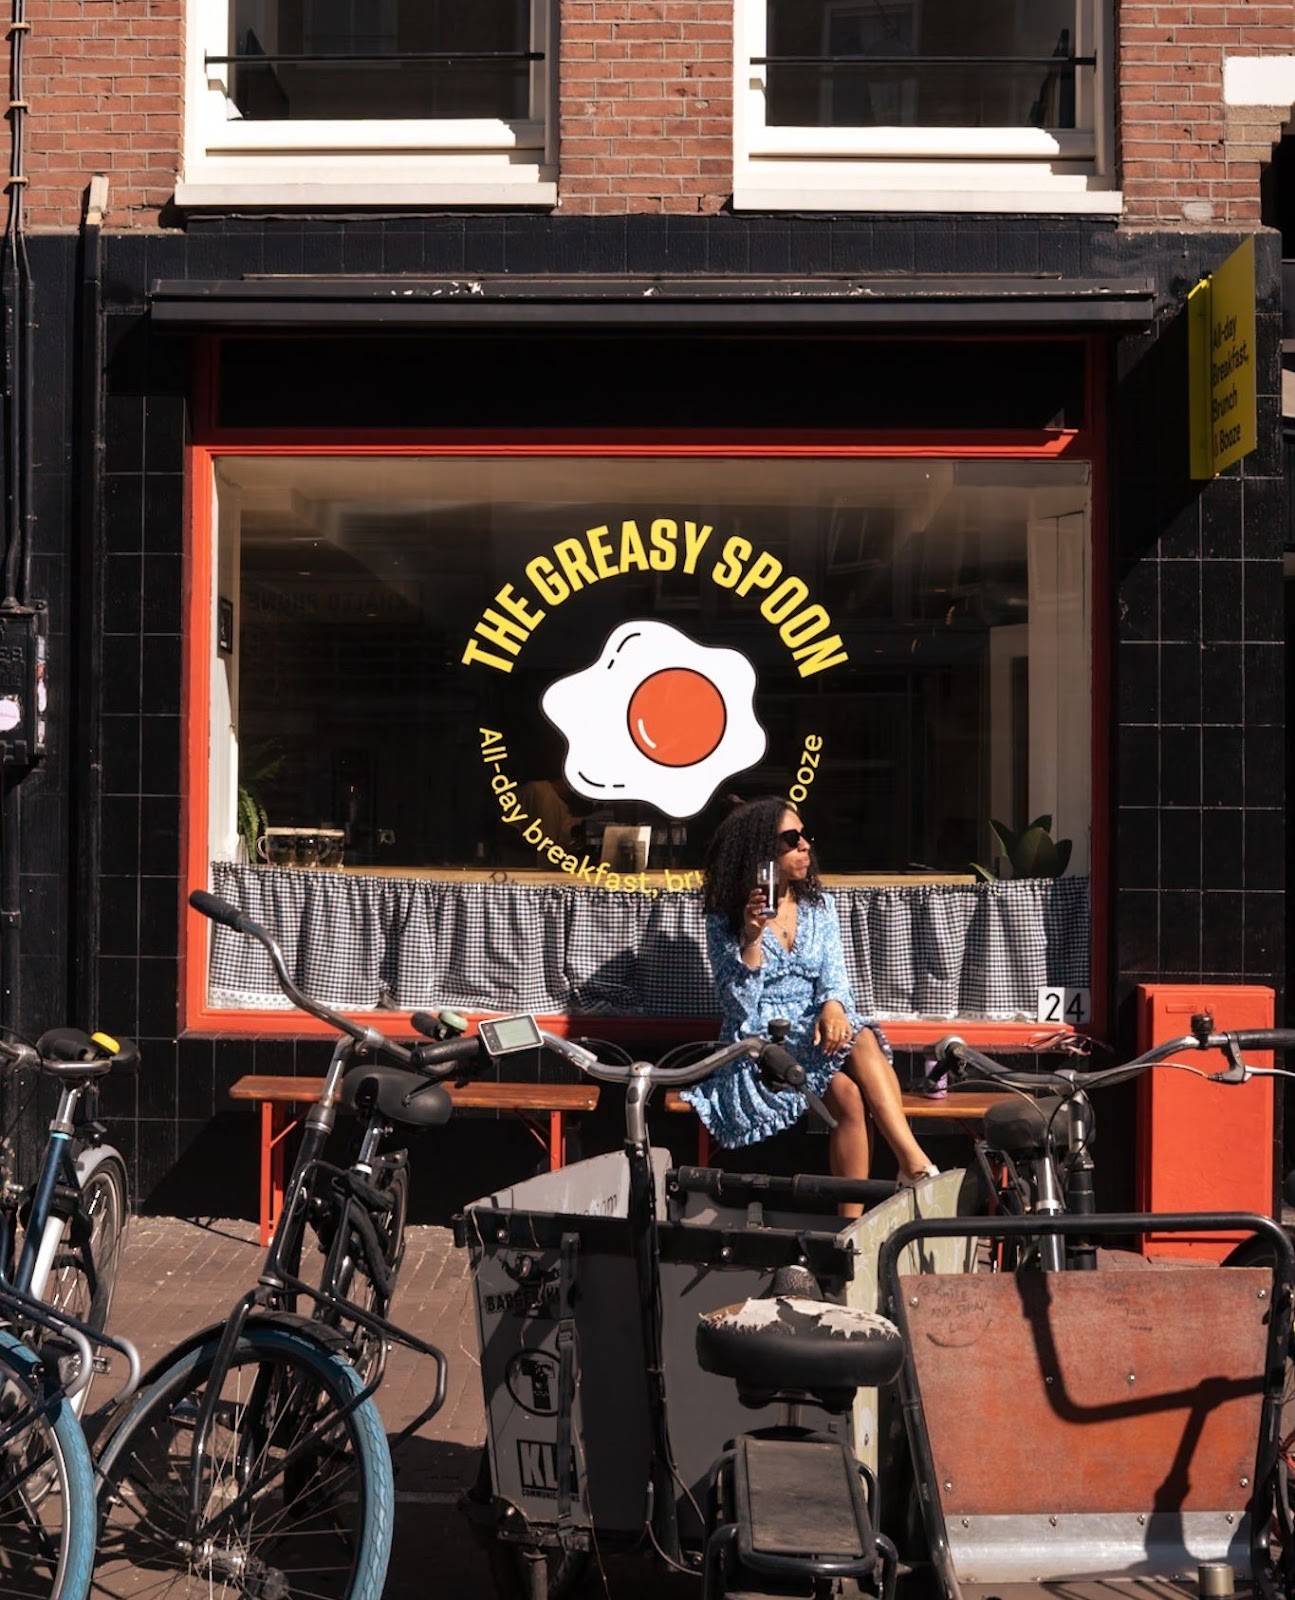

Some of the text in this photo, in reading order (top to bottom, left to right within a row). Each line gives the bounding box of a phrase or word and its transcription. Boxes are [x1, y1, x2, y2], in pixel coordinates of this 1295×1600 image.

[1211, 383, 1237, 422] Brunch
[1220, 423, 1241, 453] Booze
[461, 518, 849, 678] THE GREASY SPOON
[786, 734, 823, 812] ooze
[479, 727, 528, 823] All-day
[522, 818, 659, 898] breakfast,
[1045, 992, 1085, 1022] 24
[520, 1442, 575, 1490] KL
